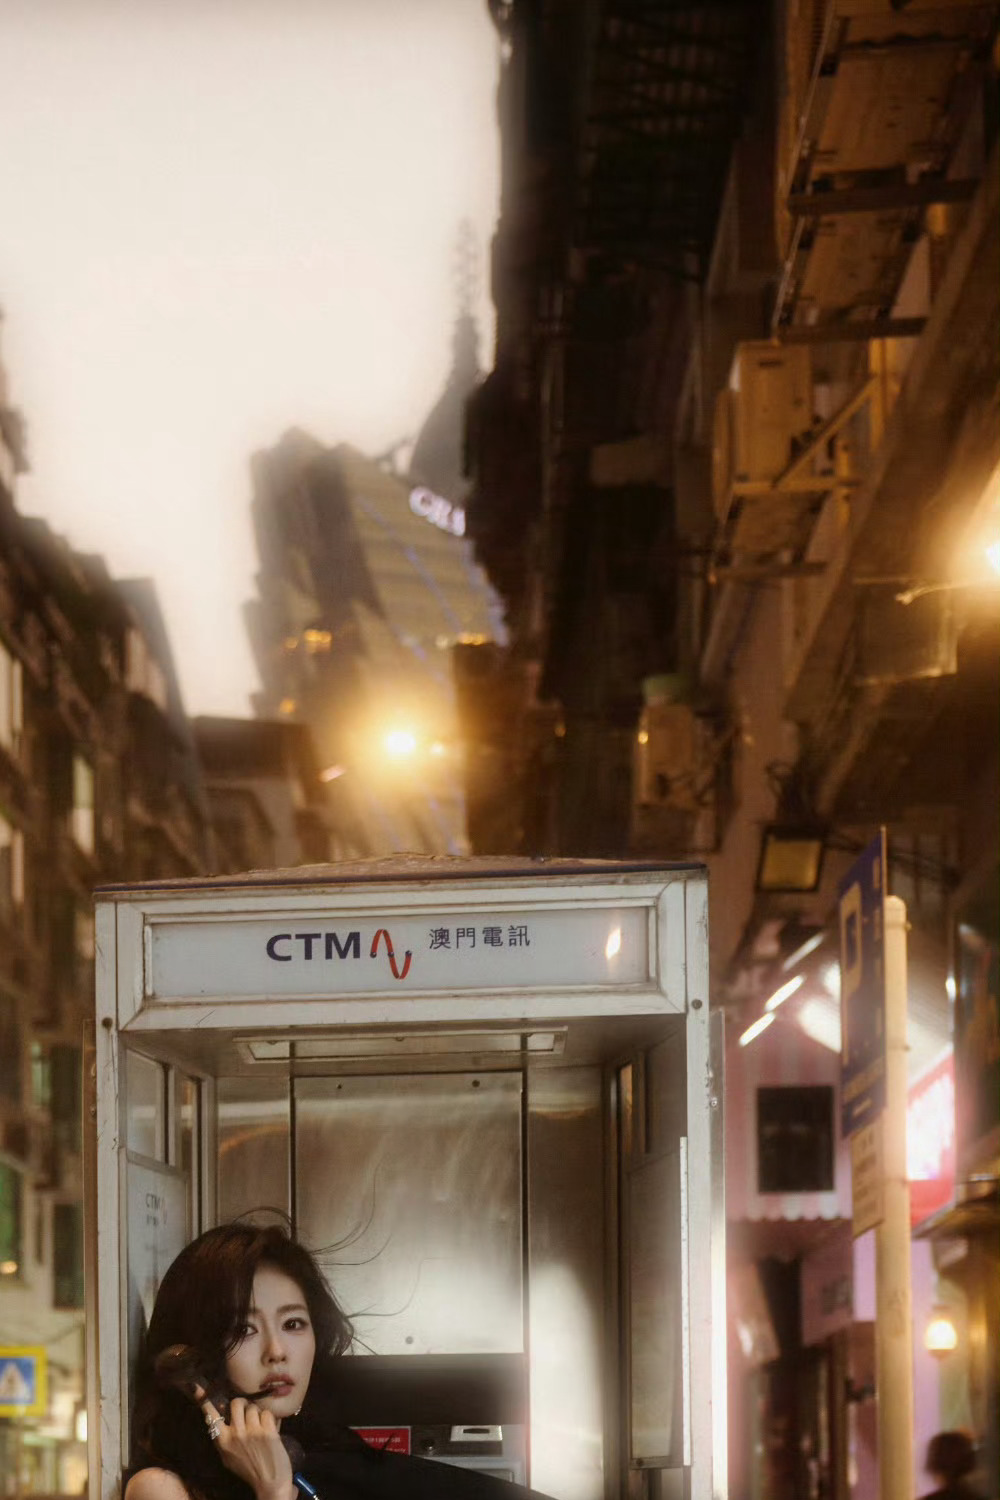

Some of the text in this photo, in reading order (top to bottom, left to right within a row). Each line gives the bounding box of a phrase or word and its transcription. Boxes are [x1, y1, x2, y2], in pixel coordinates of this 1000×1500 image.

[266, 932, 361, 962] CTM
[428, 925, 531, 950] 澳門電訊
